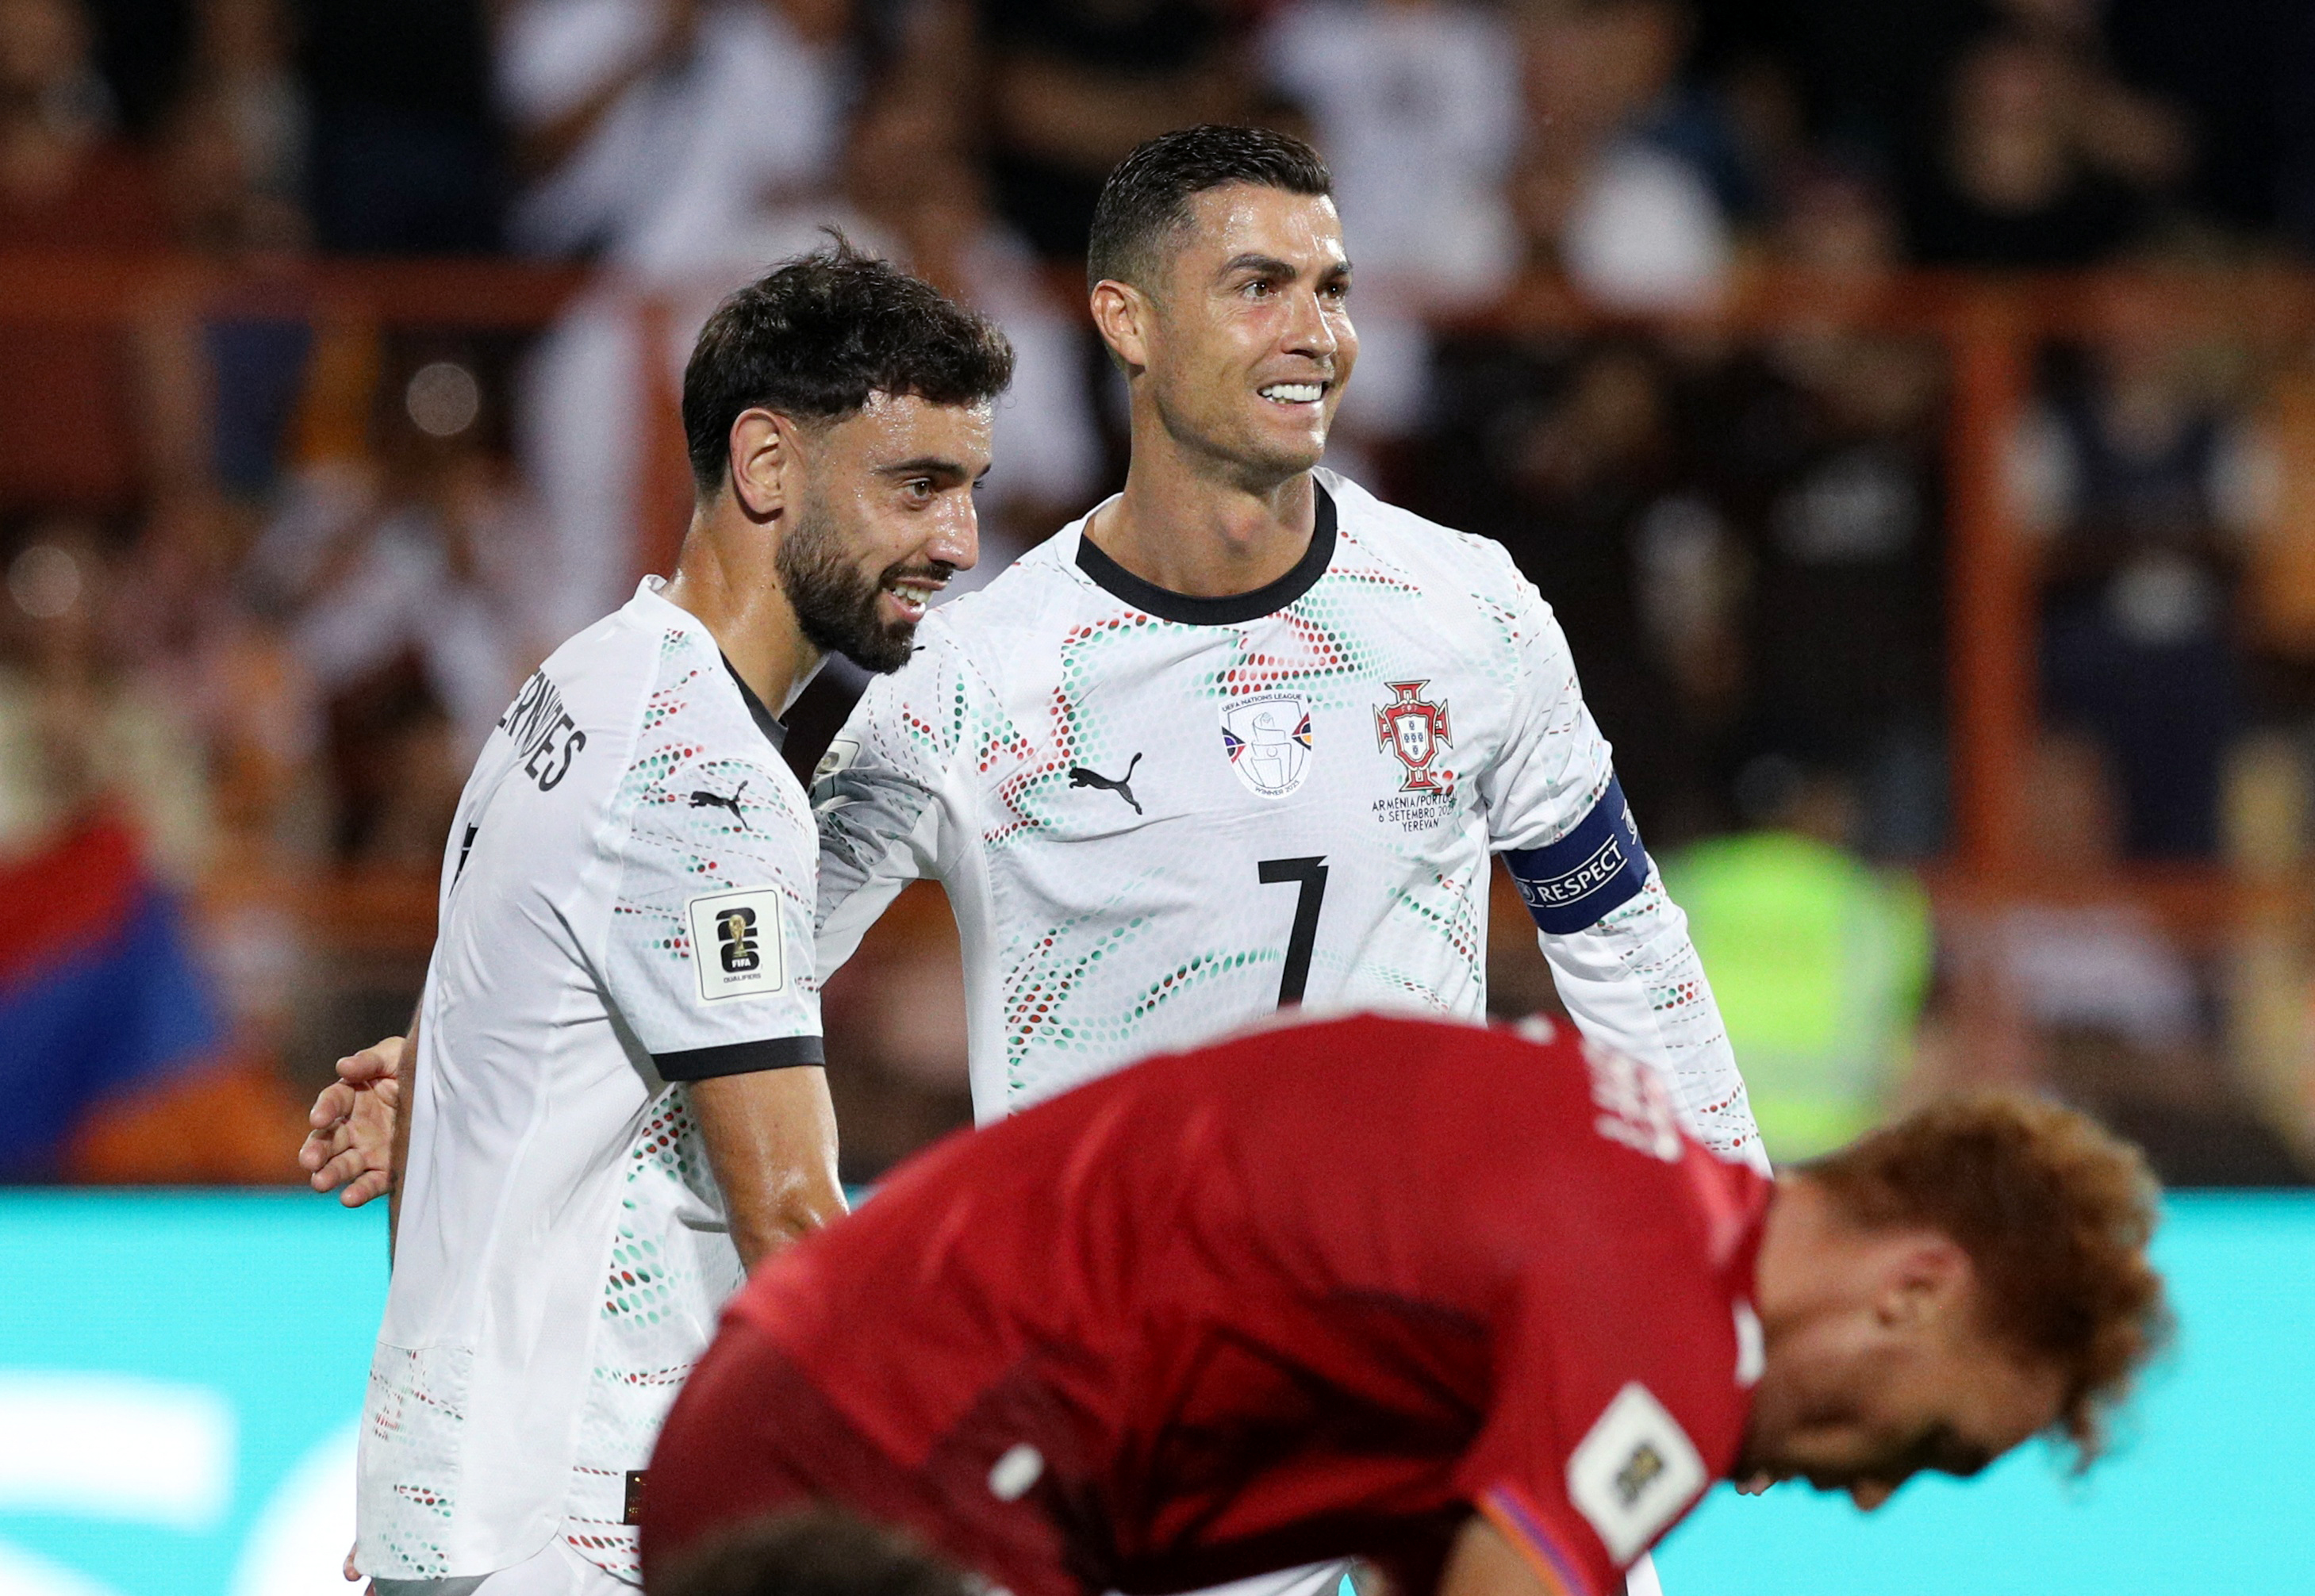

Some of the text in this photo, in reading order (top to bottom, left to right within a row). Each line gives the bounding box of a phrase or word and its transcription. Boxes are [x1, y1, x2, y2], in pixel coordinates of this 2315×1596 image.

[1222, 700, 1240, 712] UEFA
[1241, 695, 1273, 705] NATIONS
[1378, 813, 1384, 823] 6
[1388, 808, 1435, 822] SETEMBRO
[1402, 818, 1439, 832] YEREVAN
[1538, 840, 1622, 902] RESPECT
[1257, 855, 1329, 1011] 7
[731, 957, 751, 968] FIFA
[724, 973, 762, 984] QUALIFIERS
